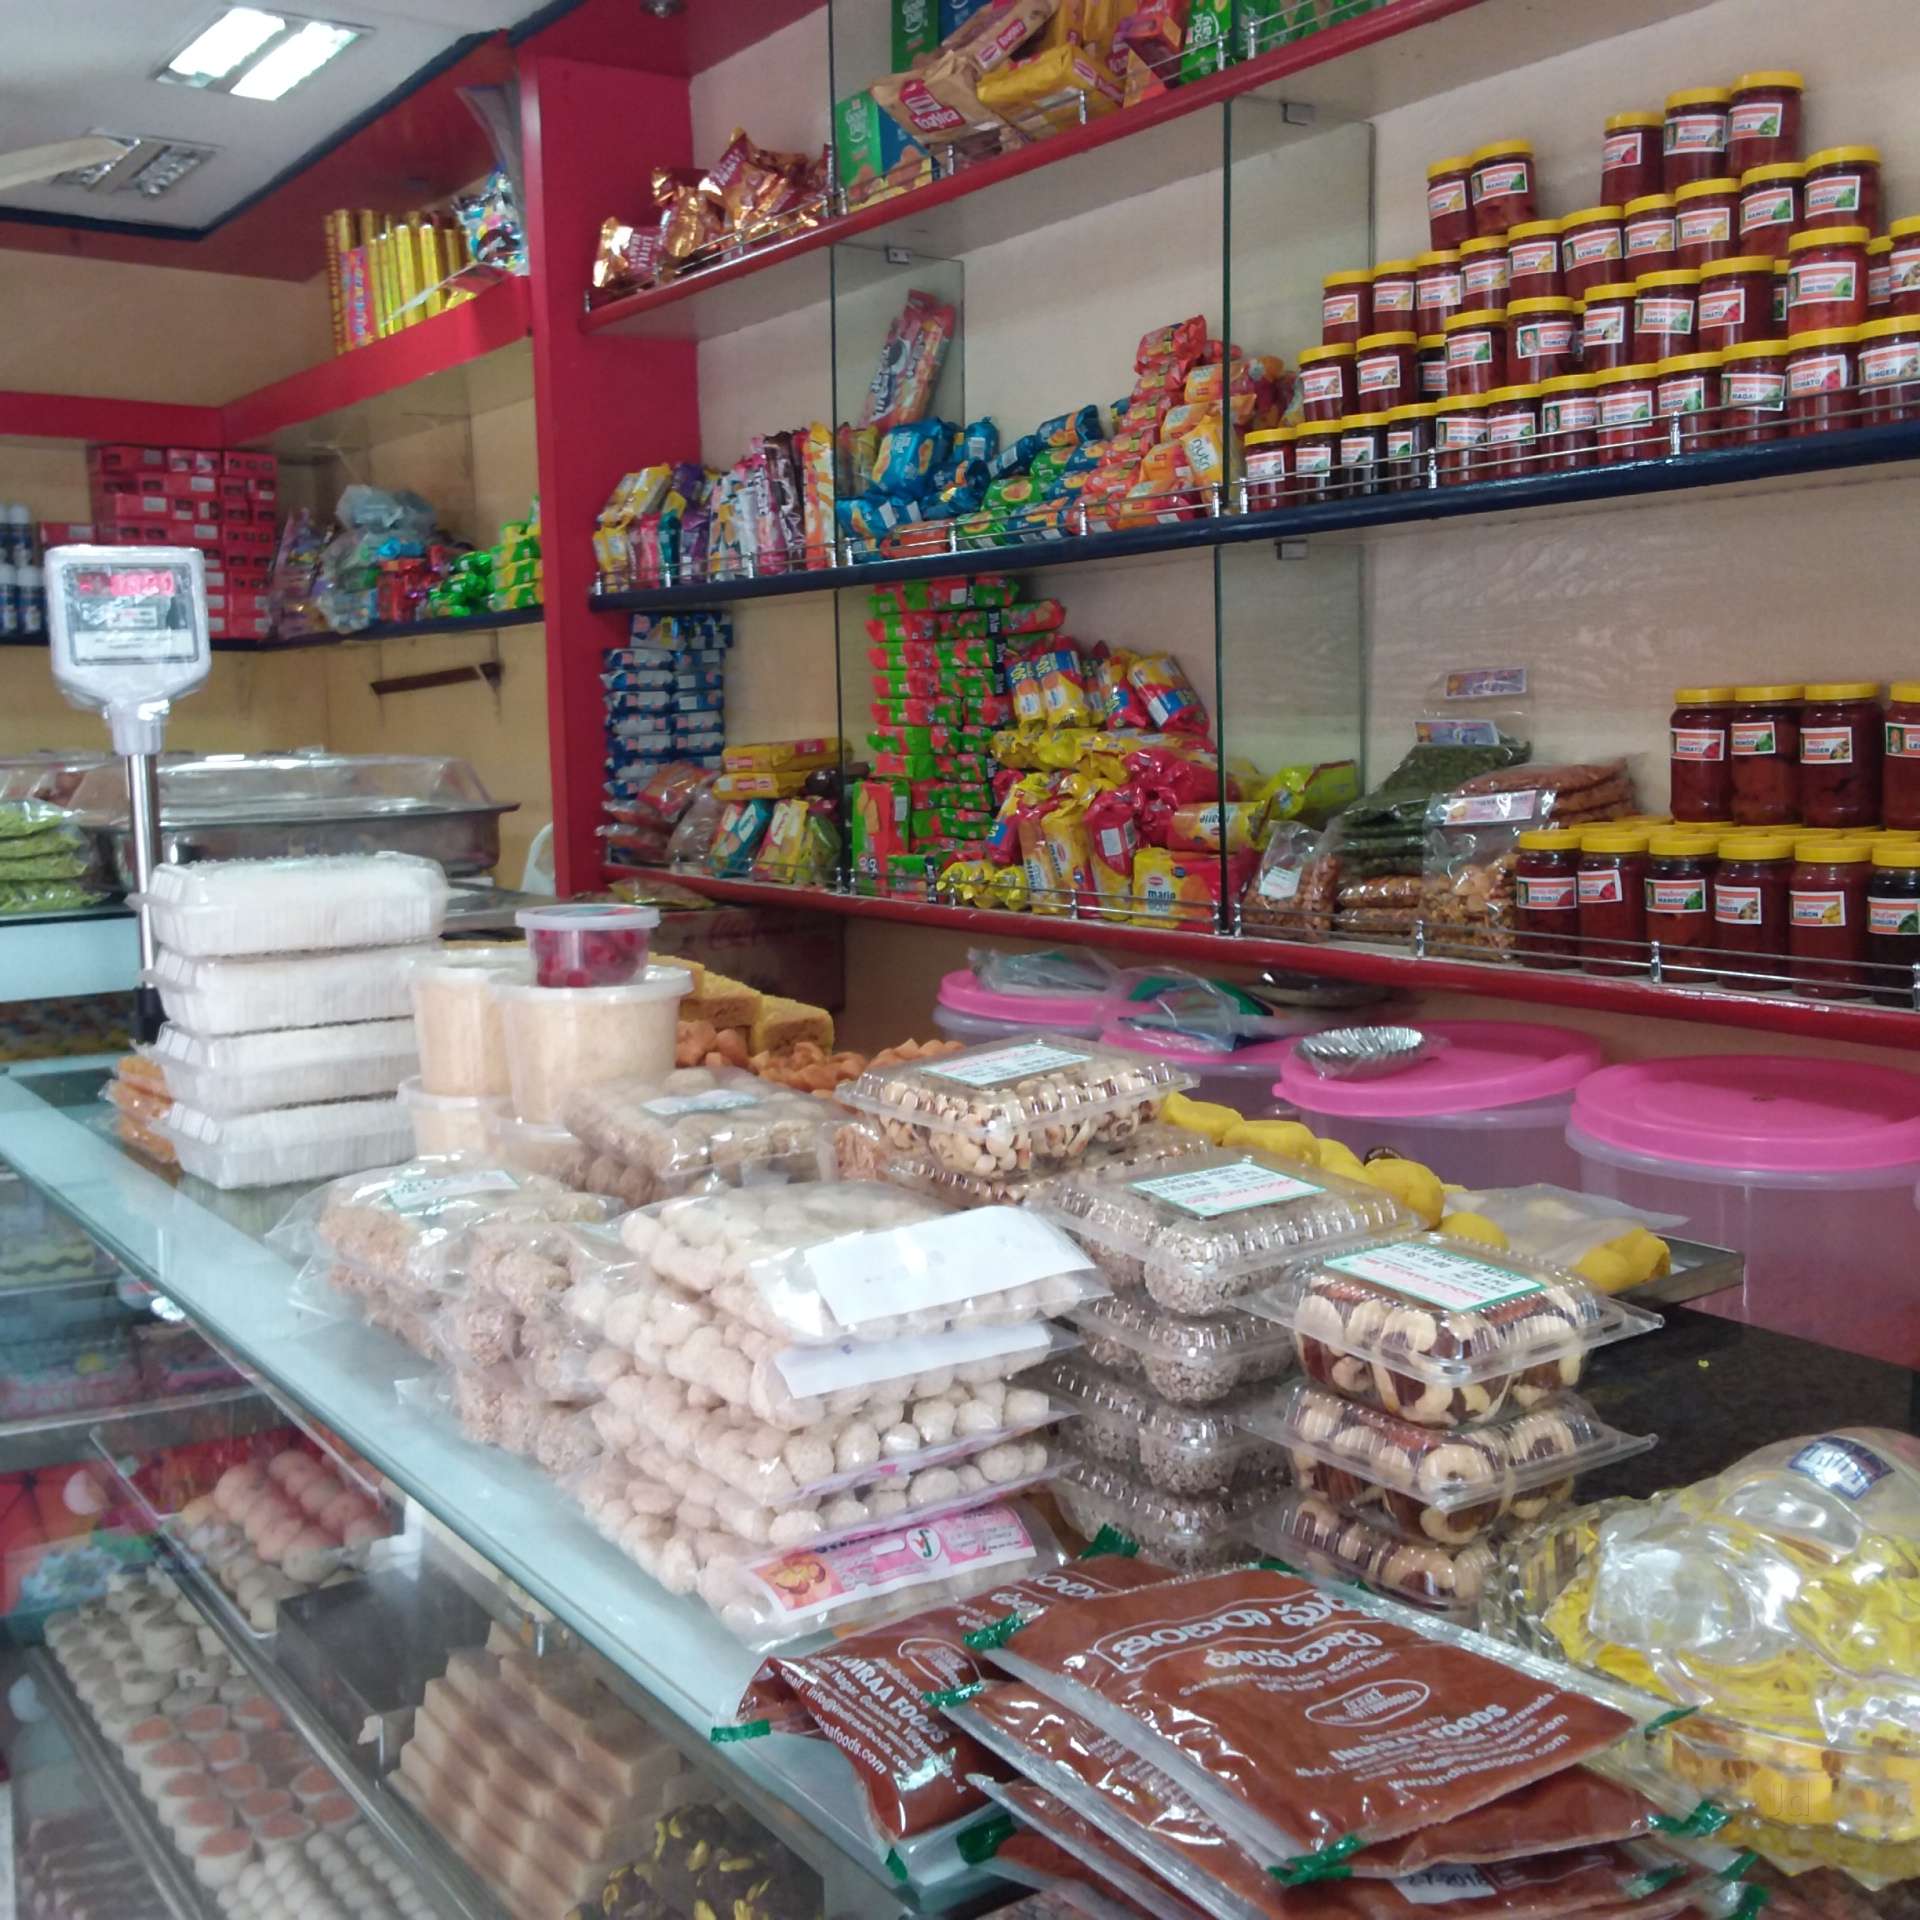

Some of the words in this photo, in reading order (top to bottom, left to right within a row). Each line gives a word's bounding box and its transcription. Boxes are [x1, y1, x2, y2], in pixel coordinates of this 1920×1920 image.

[1577, 247, 1603, 258] LEMON
[888, 1697, 949, 1744] FOODS
[1427, 1703, 1508, 1740] FOODS
